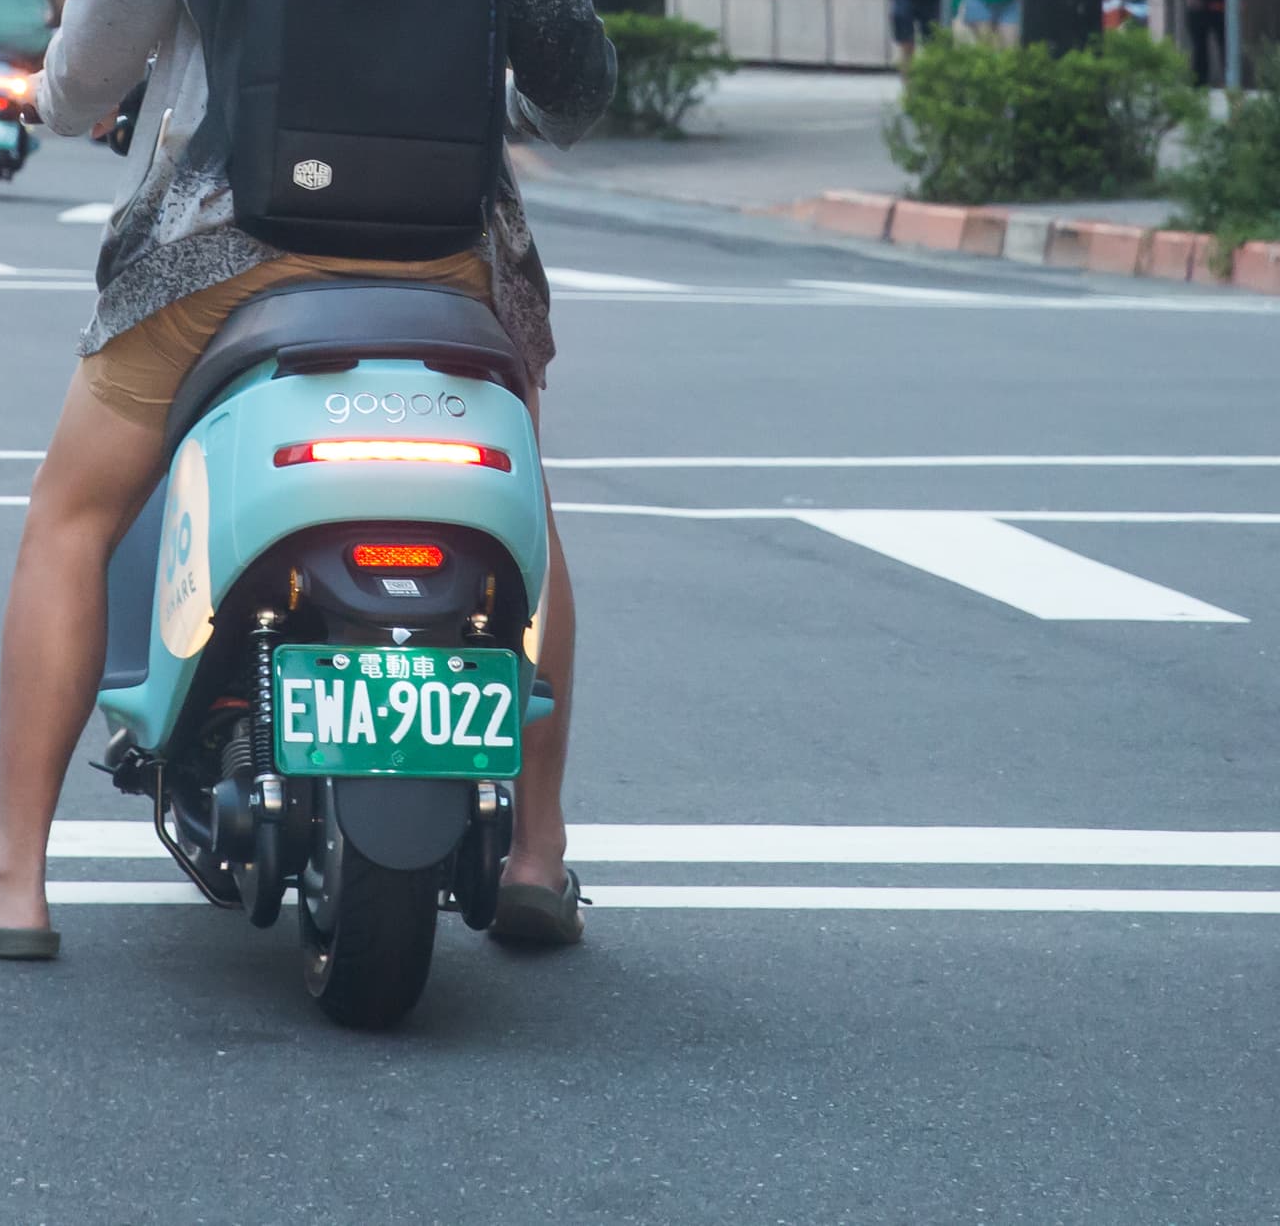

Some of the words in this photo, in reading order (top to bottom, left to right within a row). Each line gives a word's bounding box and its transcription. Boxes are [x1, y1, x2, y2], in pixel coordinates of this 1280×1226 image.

[325, 391, 466, 424] gogoro
[358, 653, 436, 679] 電動車
